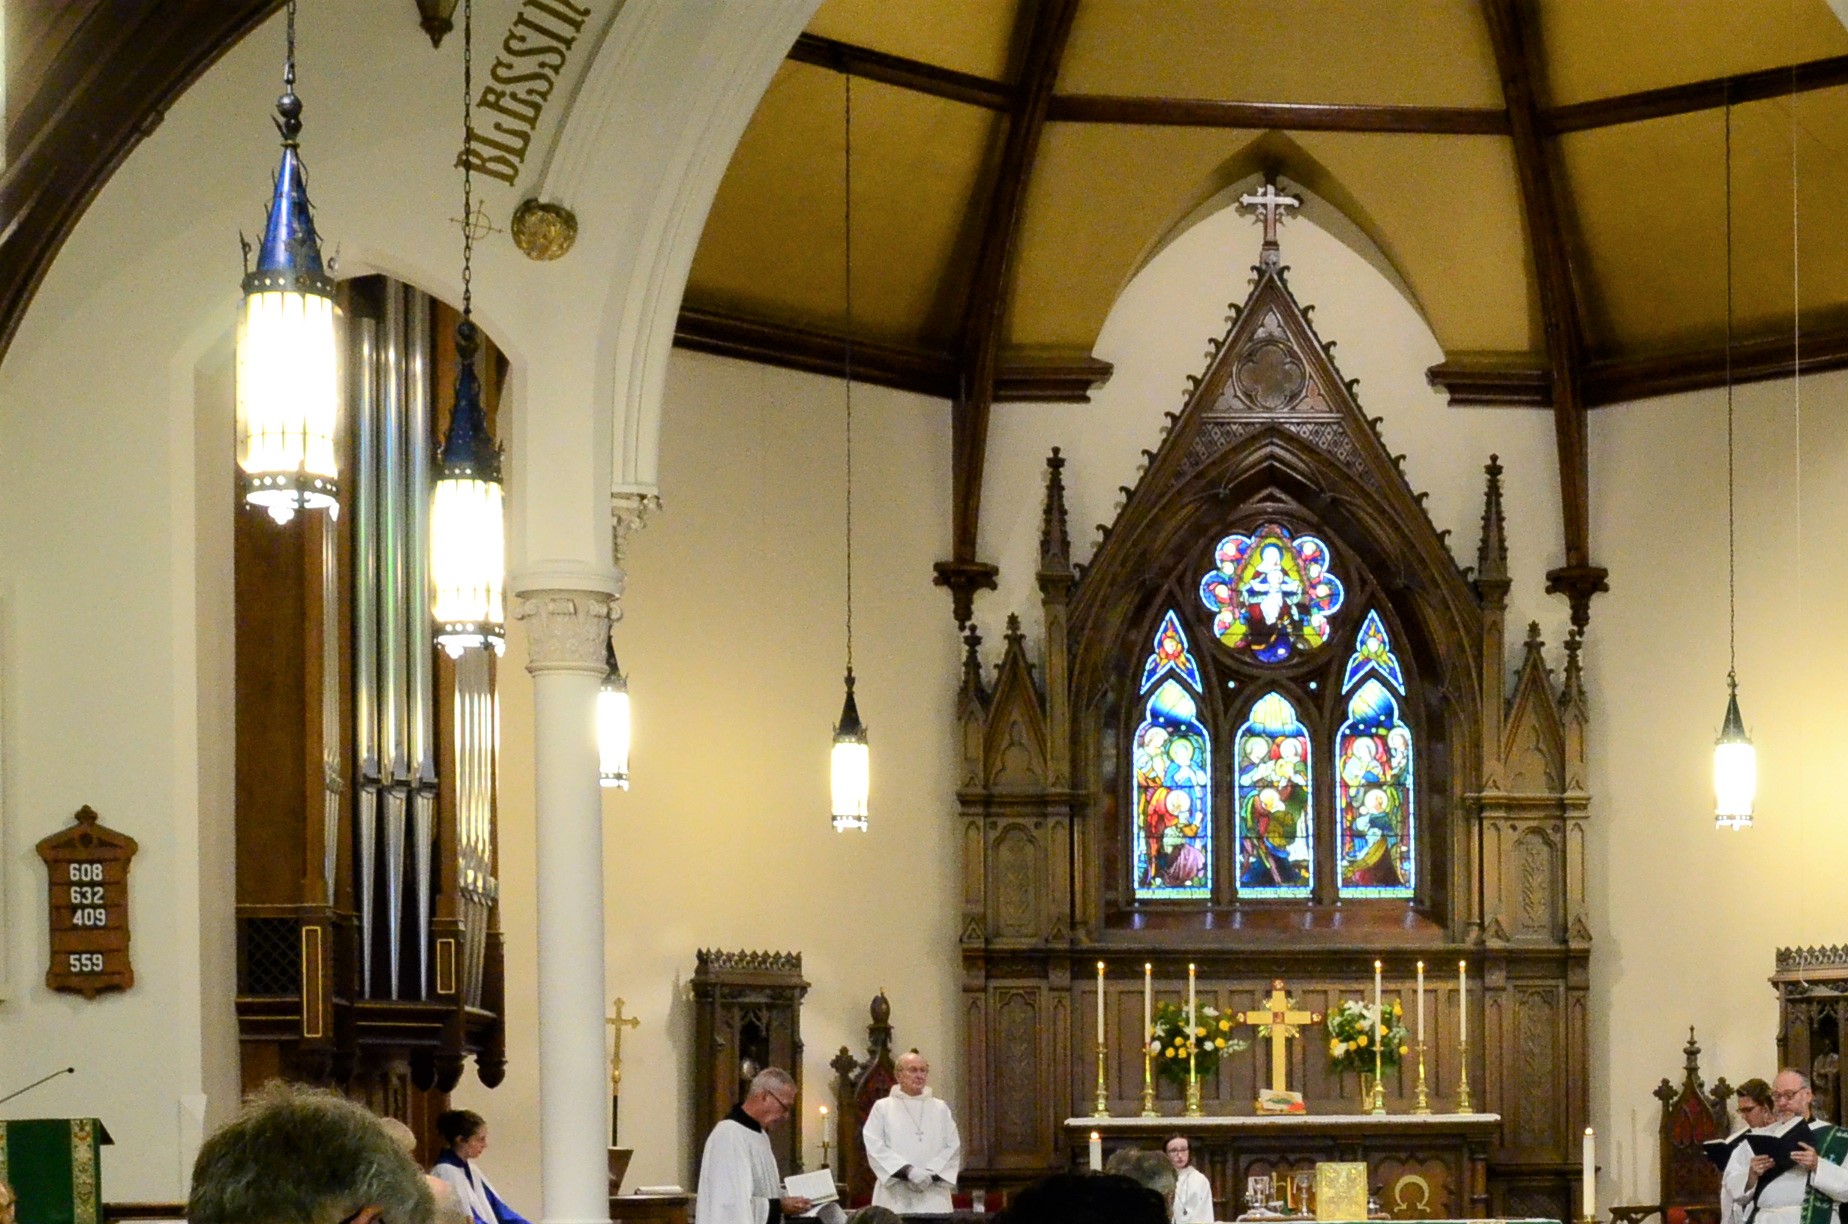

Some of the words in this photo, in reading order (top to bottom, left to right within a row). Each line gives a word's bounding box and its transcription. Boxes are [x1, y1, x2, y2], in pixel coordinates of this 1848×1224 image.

[69, 863, 103, 881] 608
[70, 886, 104, 904] 632
[72, 908, 106, 926] 409
[69, 954, 103, 972] 559
